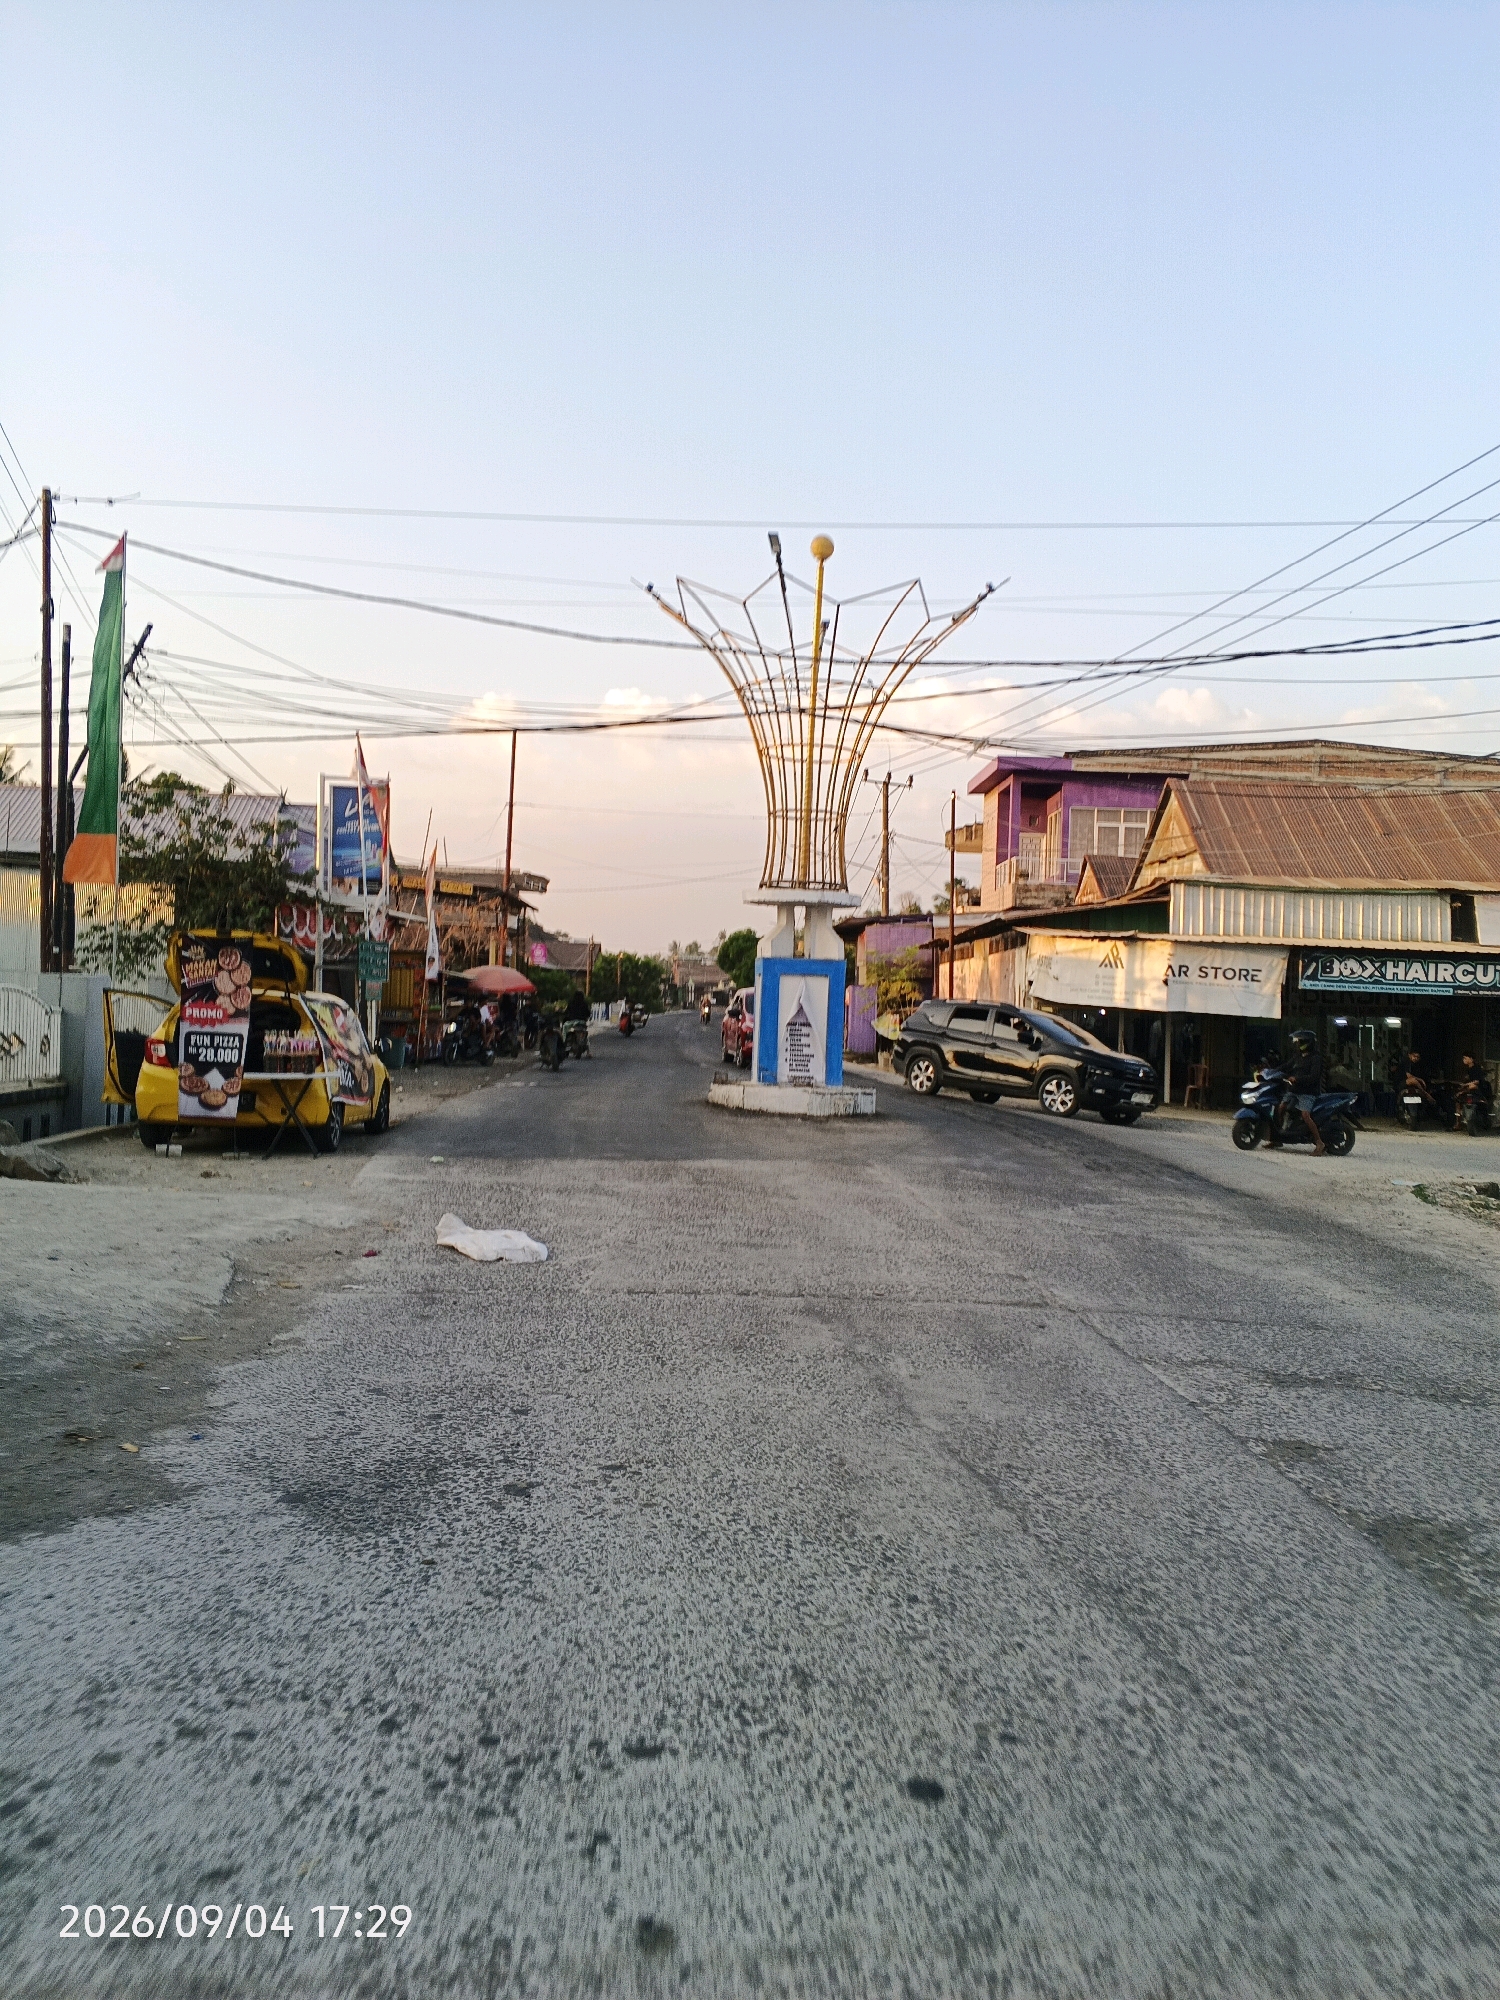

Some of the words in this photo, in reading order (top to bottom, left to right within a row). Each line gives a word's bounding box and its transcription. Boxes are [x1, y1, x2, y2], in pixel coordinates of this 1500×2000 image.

[1164, 964, 1189, 978] AR
[1198, 966, 1262, 983] STORE
[1386, 961, 1500, 984] HAIRCU
[185, 1007, 223, 1019] PROMO
[190, 1034, 211, 1047] FUN
[214, 1035, 240, 1049] PIZZA
